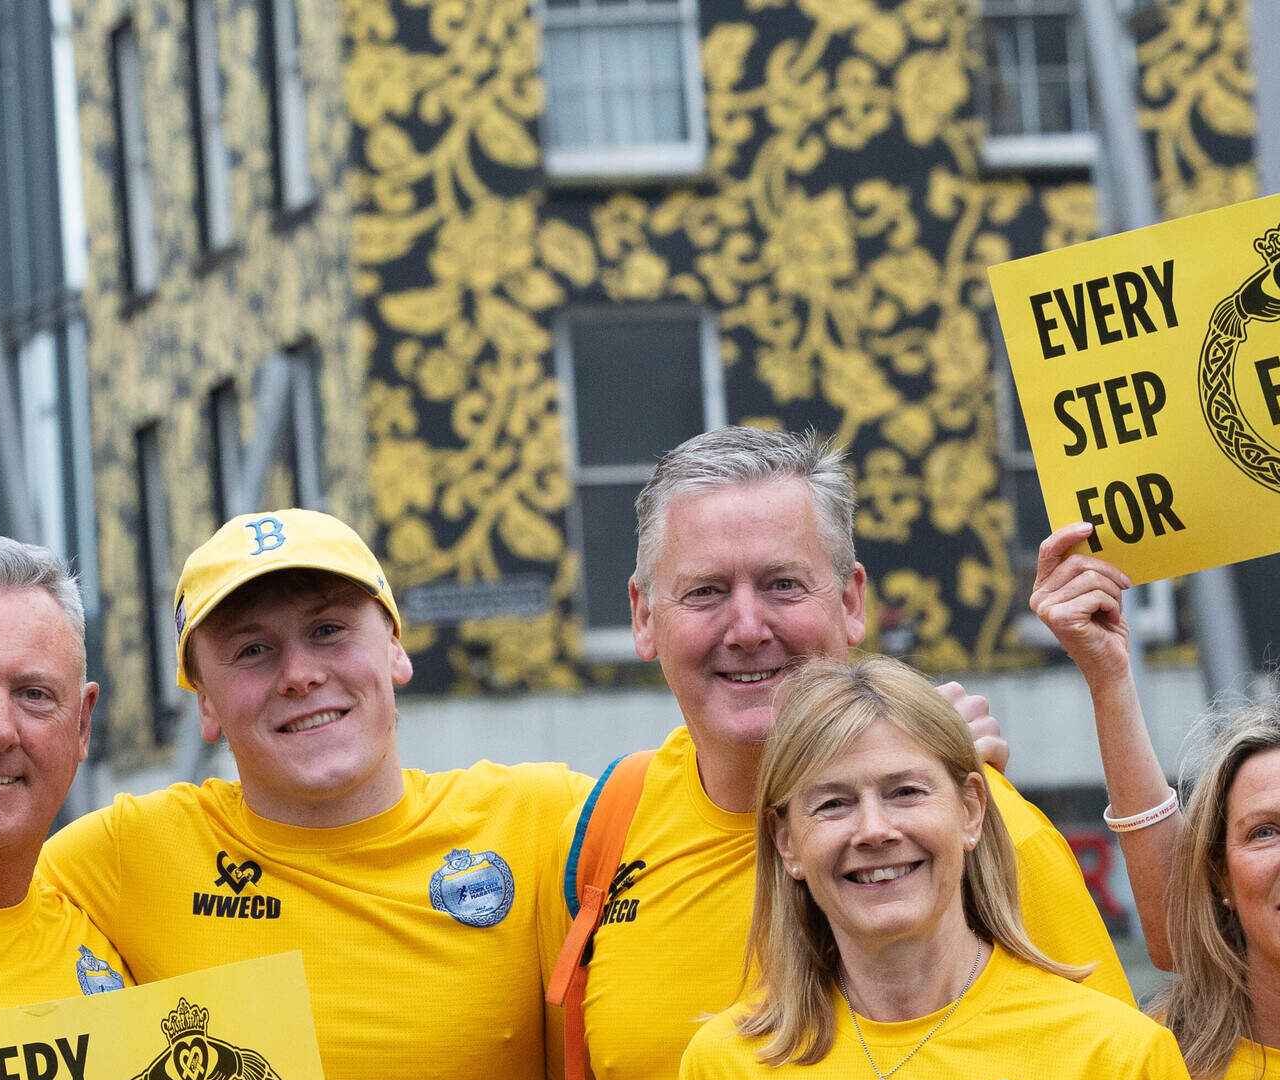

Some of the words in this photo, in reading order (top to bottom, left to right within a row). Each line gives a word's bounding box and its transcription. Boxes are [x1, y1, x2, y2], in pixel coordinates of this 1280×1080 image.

[1030, 260, 1178, 359] EVERY
[1054, 371, 1166, 456] STEP
[245, 516, 286, 556] B
[1076, 473, 1186, 552] FOR
[192, 892, 282, 919] WWECD
[599, 899, 640, 928] WECD
